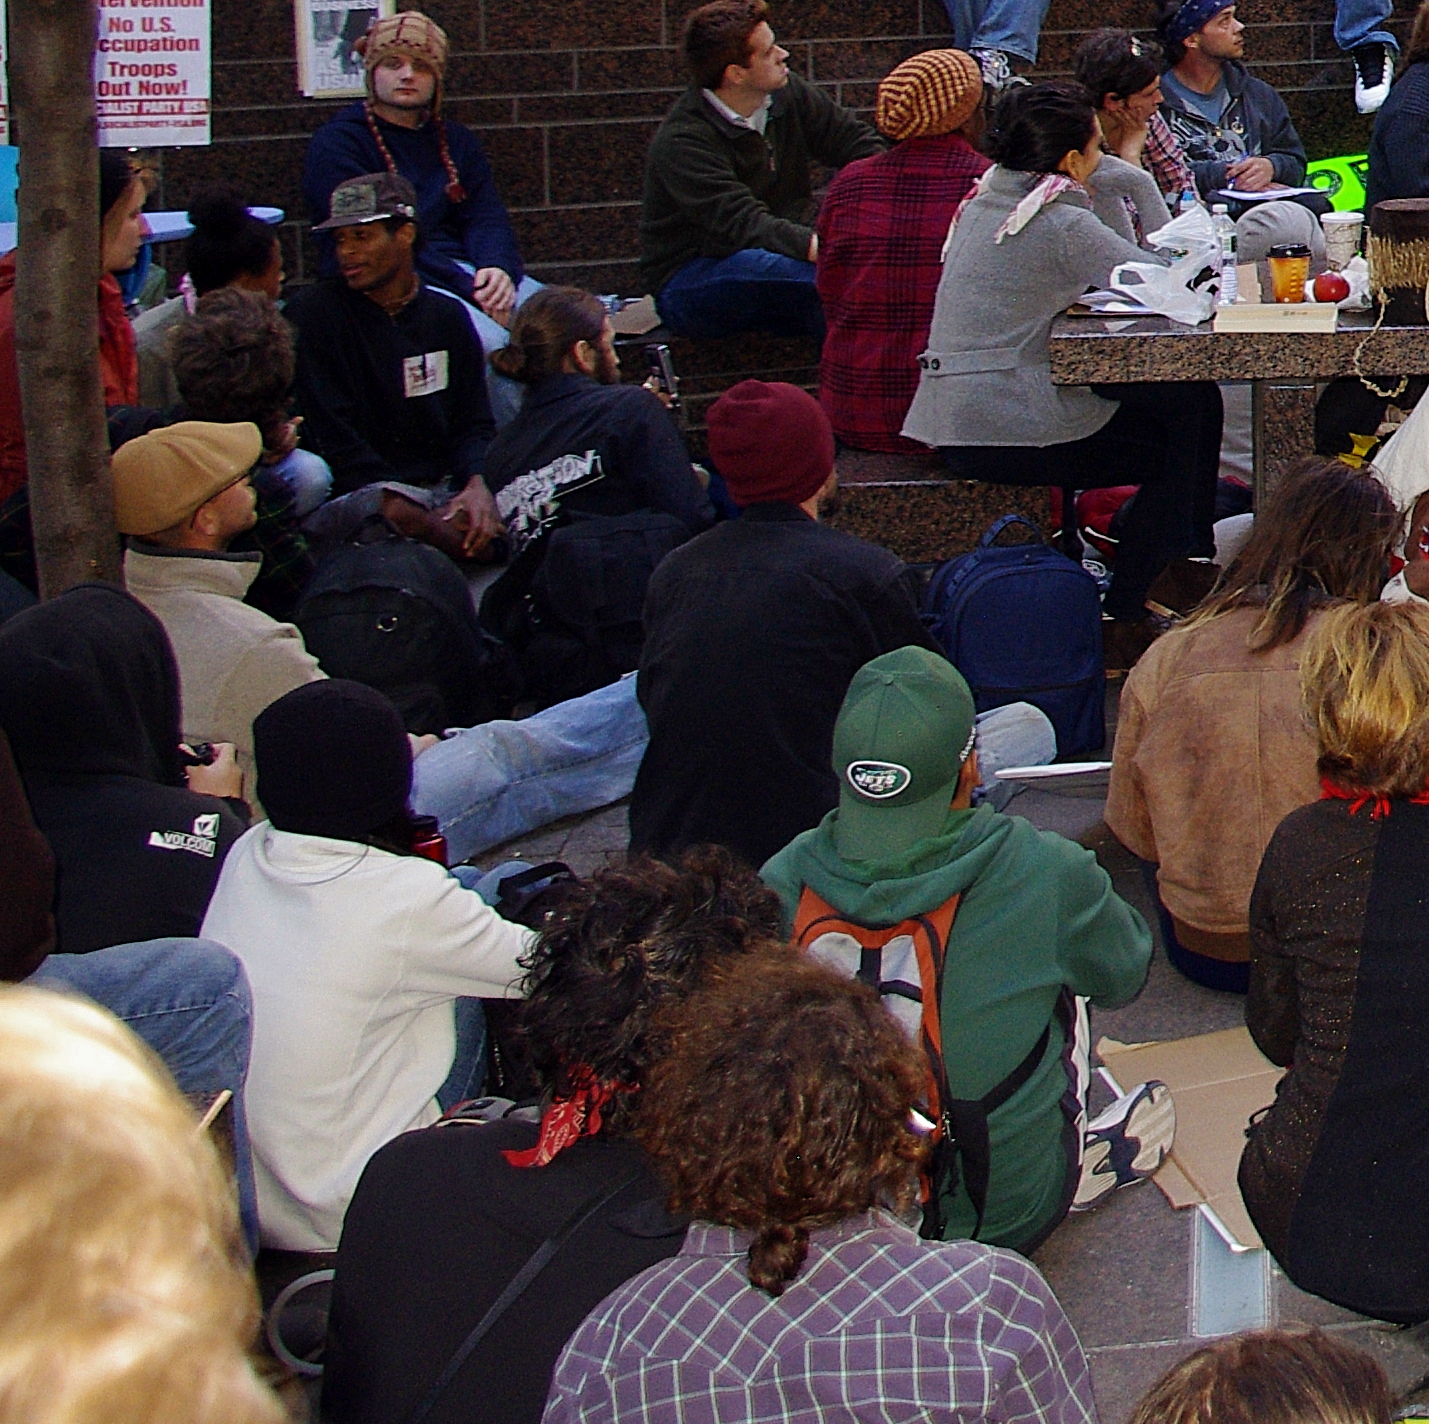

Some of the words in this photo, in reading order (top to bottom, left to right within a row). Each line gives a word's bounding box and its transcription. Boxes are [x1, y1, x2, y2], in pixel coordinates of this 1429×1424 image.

[108, 17, 134, 33] No
[141, 16, 176, 33] U.S.
[98, 35, 200, 54] ccupation
[108, 61, 178, 78] Troops
[97, 81, 131, 97] Out
[138, 80, 188, 96] Now!
[854, 772, 898, 785] JETS
[163, 831, 214, 854] VOLCOM
